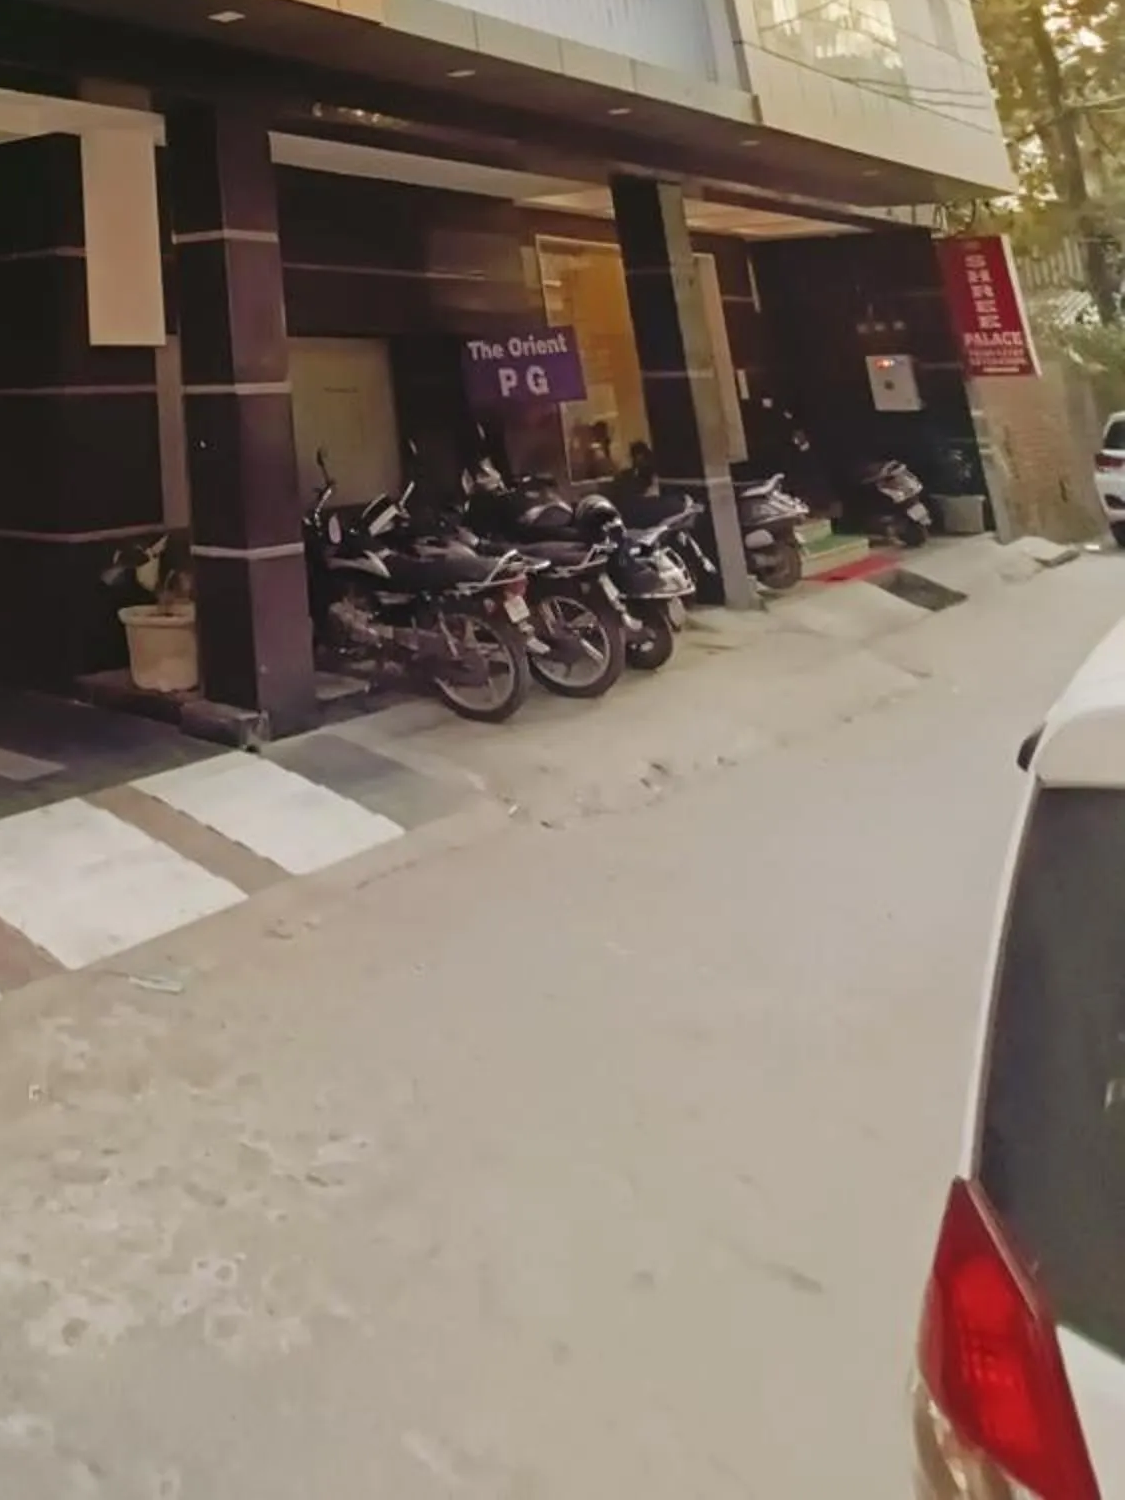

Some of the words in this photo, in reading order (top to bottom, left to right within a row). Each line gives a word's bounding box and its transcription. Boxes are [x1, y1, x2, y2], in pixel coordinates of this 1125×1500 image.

[964, 254, 1002, 329] SHREE
[466, 340, 504, 361] The
[508, 333, 568, 357] Orient
[963, 331, 1024, 346] PALACE
